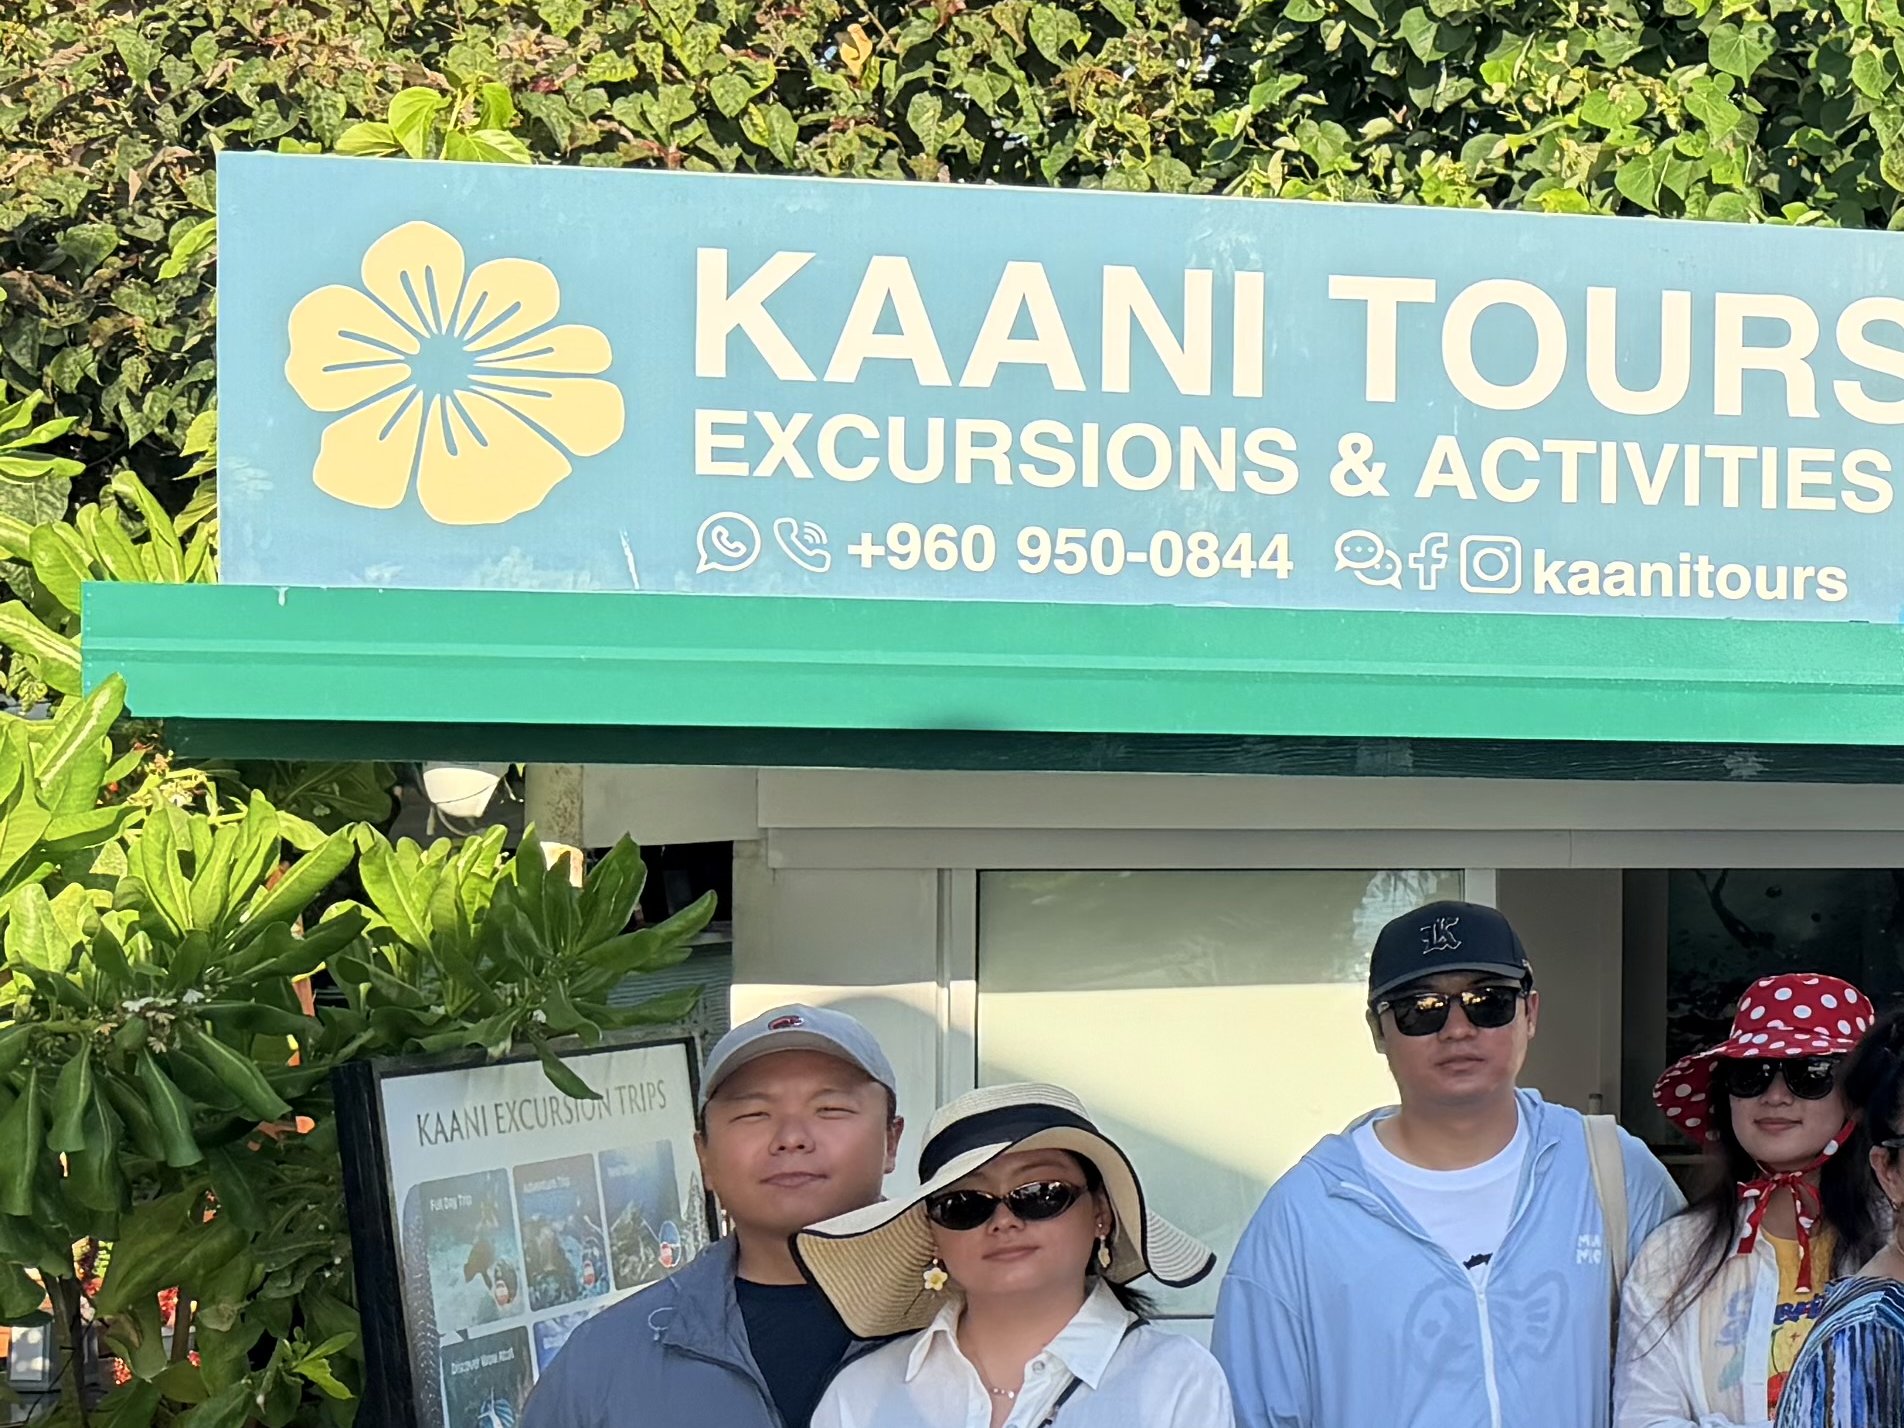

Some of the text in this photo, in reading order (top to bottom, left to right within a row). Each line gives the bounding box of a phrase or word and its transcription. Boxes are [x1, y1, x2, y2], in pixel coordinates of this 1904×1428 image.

[695, 247, 1265, 398] KAANI
[694, 408, 1894, 514] EXCURSIONS & ACTIVITIES
[847, 521, 1295, 579] +960 950-0844
[1533, 548, 1848, 602] kaanitours
[417, 1080, 667, 1147] KAANI EXCURSION TRIPS
